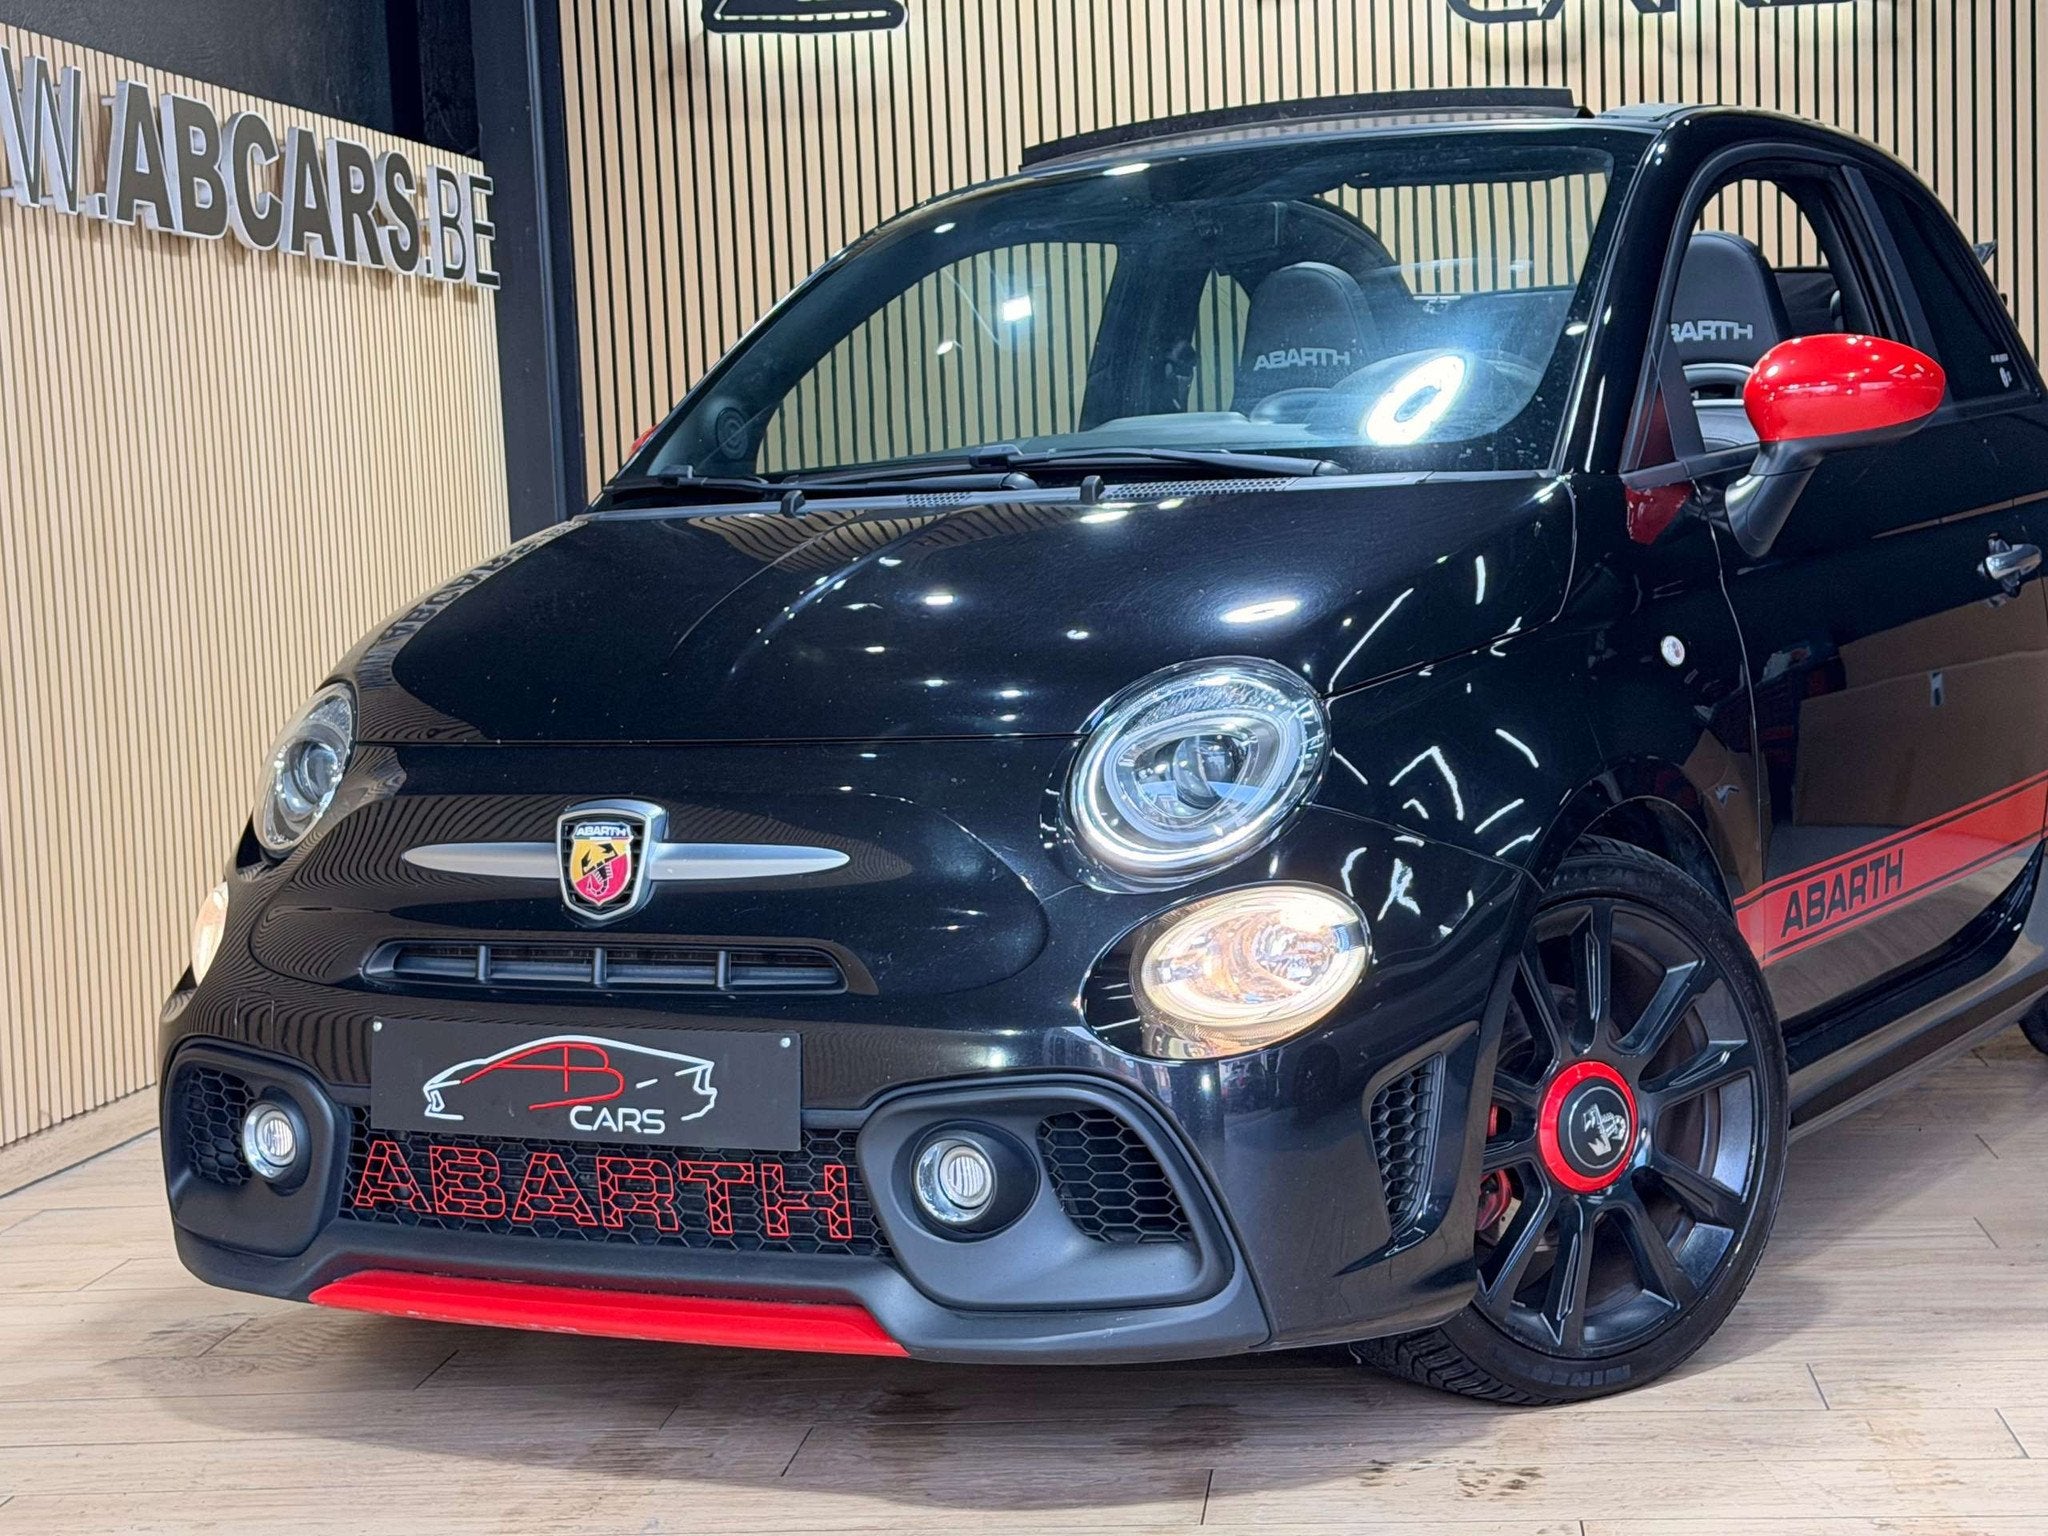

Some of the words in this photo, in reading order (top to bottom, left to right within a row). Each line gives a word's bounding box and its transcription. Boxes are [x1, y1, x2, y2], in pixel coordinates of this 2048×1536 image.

[1671, 320, 1753, 342] BARTH
[1253, 347, 1350, 371] ABARTH
[575, 825, 627, 837] ABARTH
[1781, 849, 1904, 938] ABARTH
[570, 1105, 666, 1135] CARS
[354, 1140, 852, 1240] ABARTH
